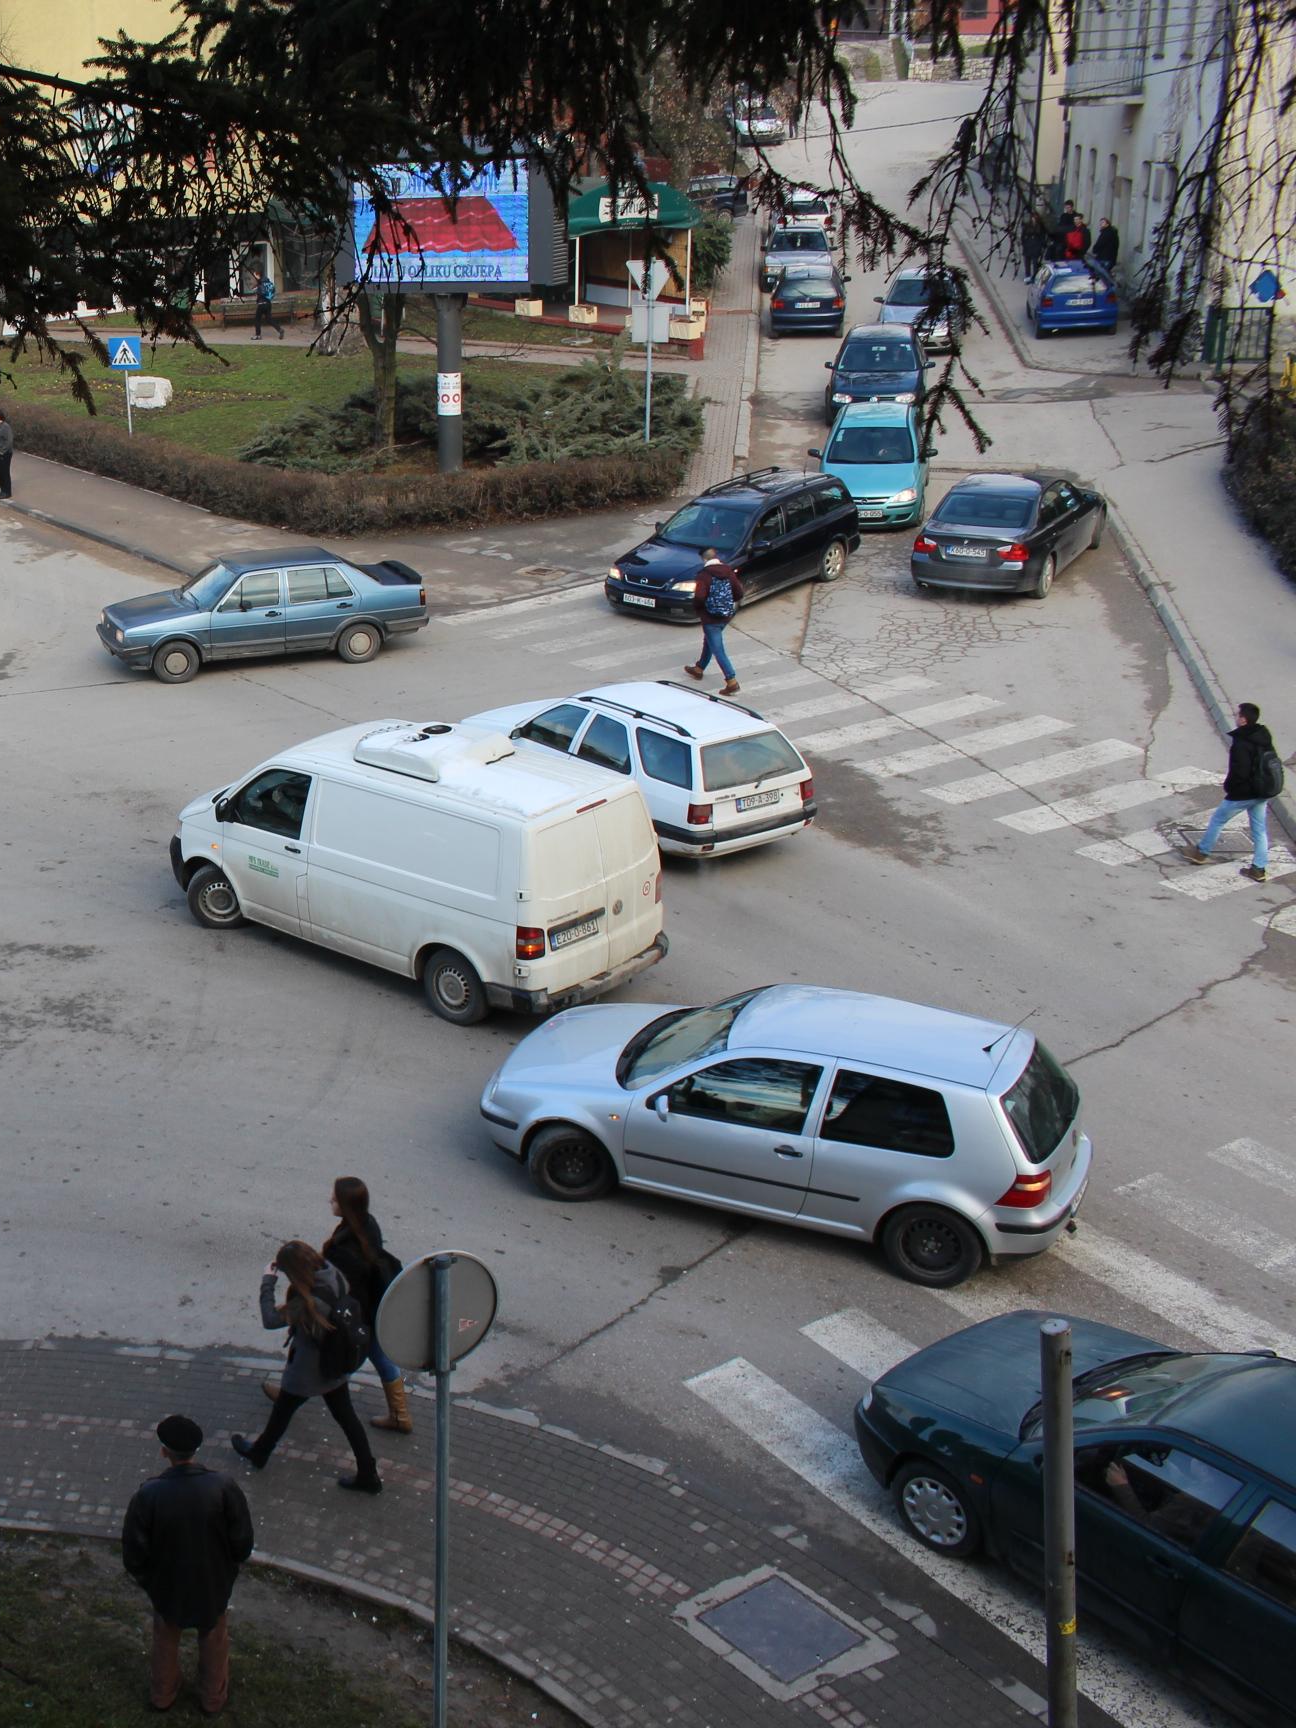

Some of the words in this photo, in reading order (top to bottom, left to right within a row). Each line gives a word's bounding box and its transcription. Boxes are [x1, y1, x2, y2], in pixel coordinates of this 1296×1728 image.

[453, 263, 503, 279] CRIJEPA
[742, 790, 779, 809] T09-A-398
[556, 919, 597, 945] E20-O-861
